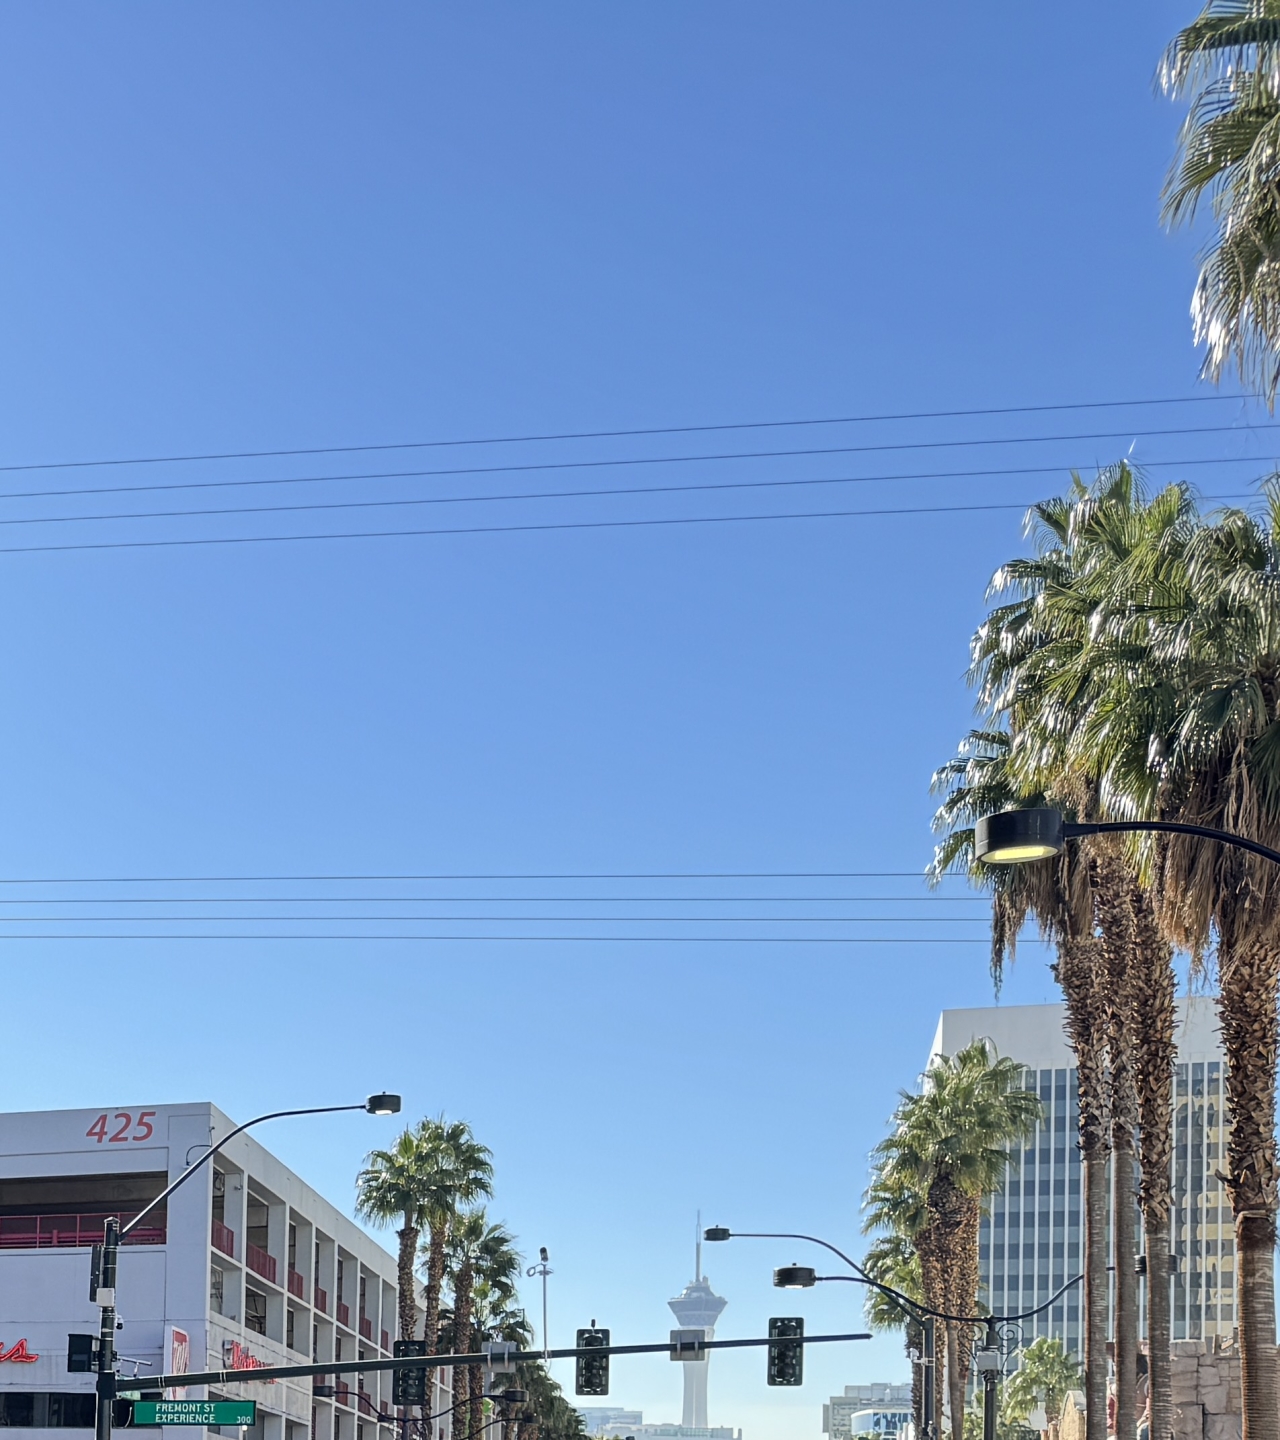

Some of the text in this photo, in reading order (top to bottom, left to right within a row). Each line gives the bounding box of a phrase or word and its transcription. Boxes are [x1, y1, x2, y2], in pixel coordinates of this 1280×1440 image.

[85, 1110, 157, 1144] 425
[155, 1403, 215, 1412] FREMONT ST
[155, 1413, 216, 1423] EXPERIENCE
